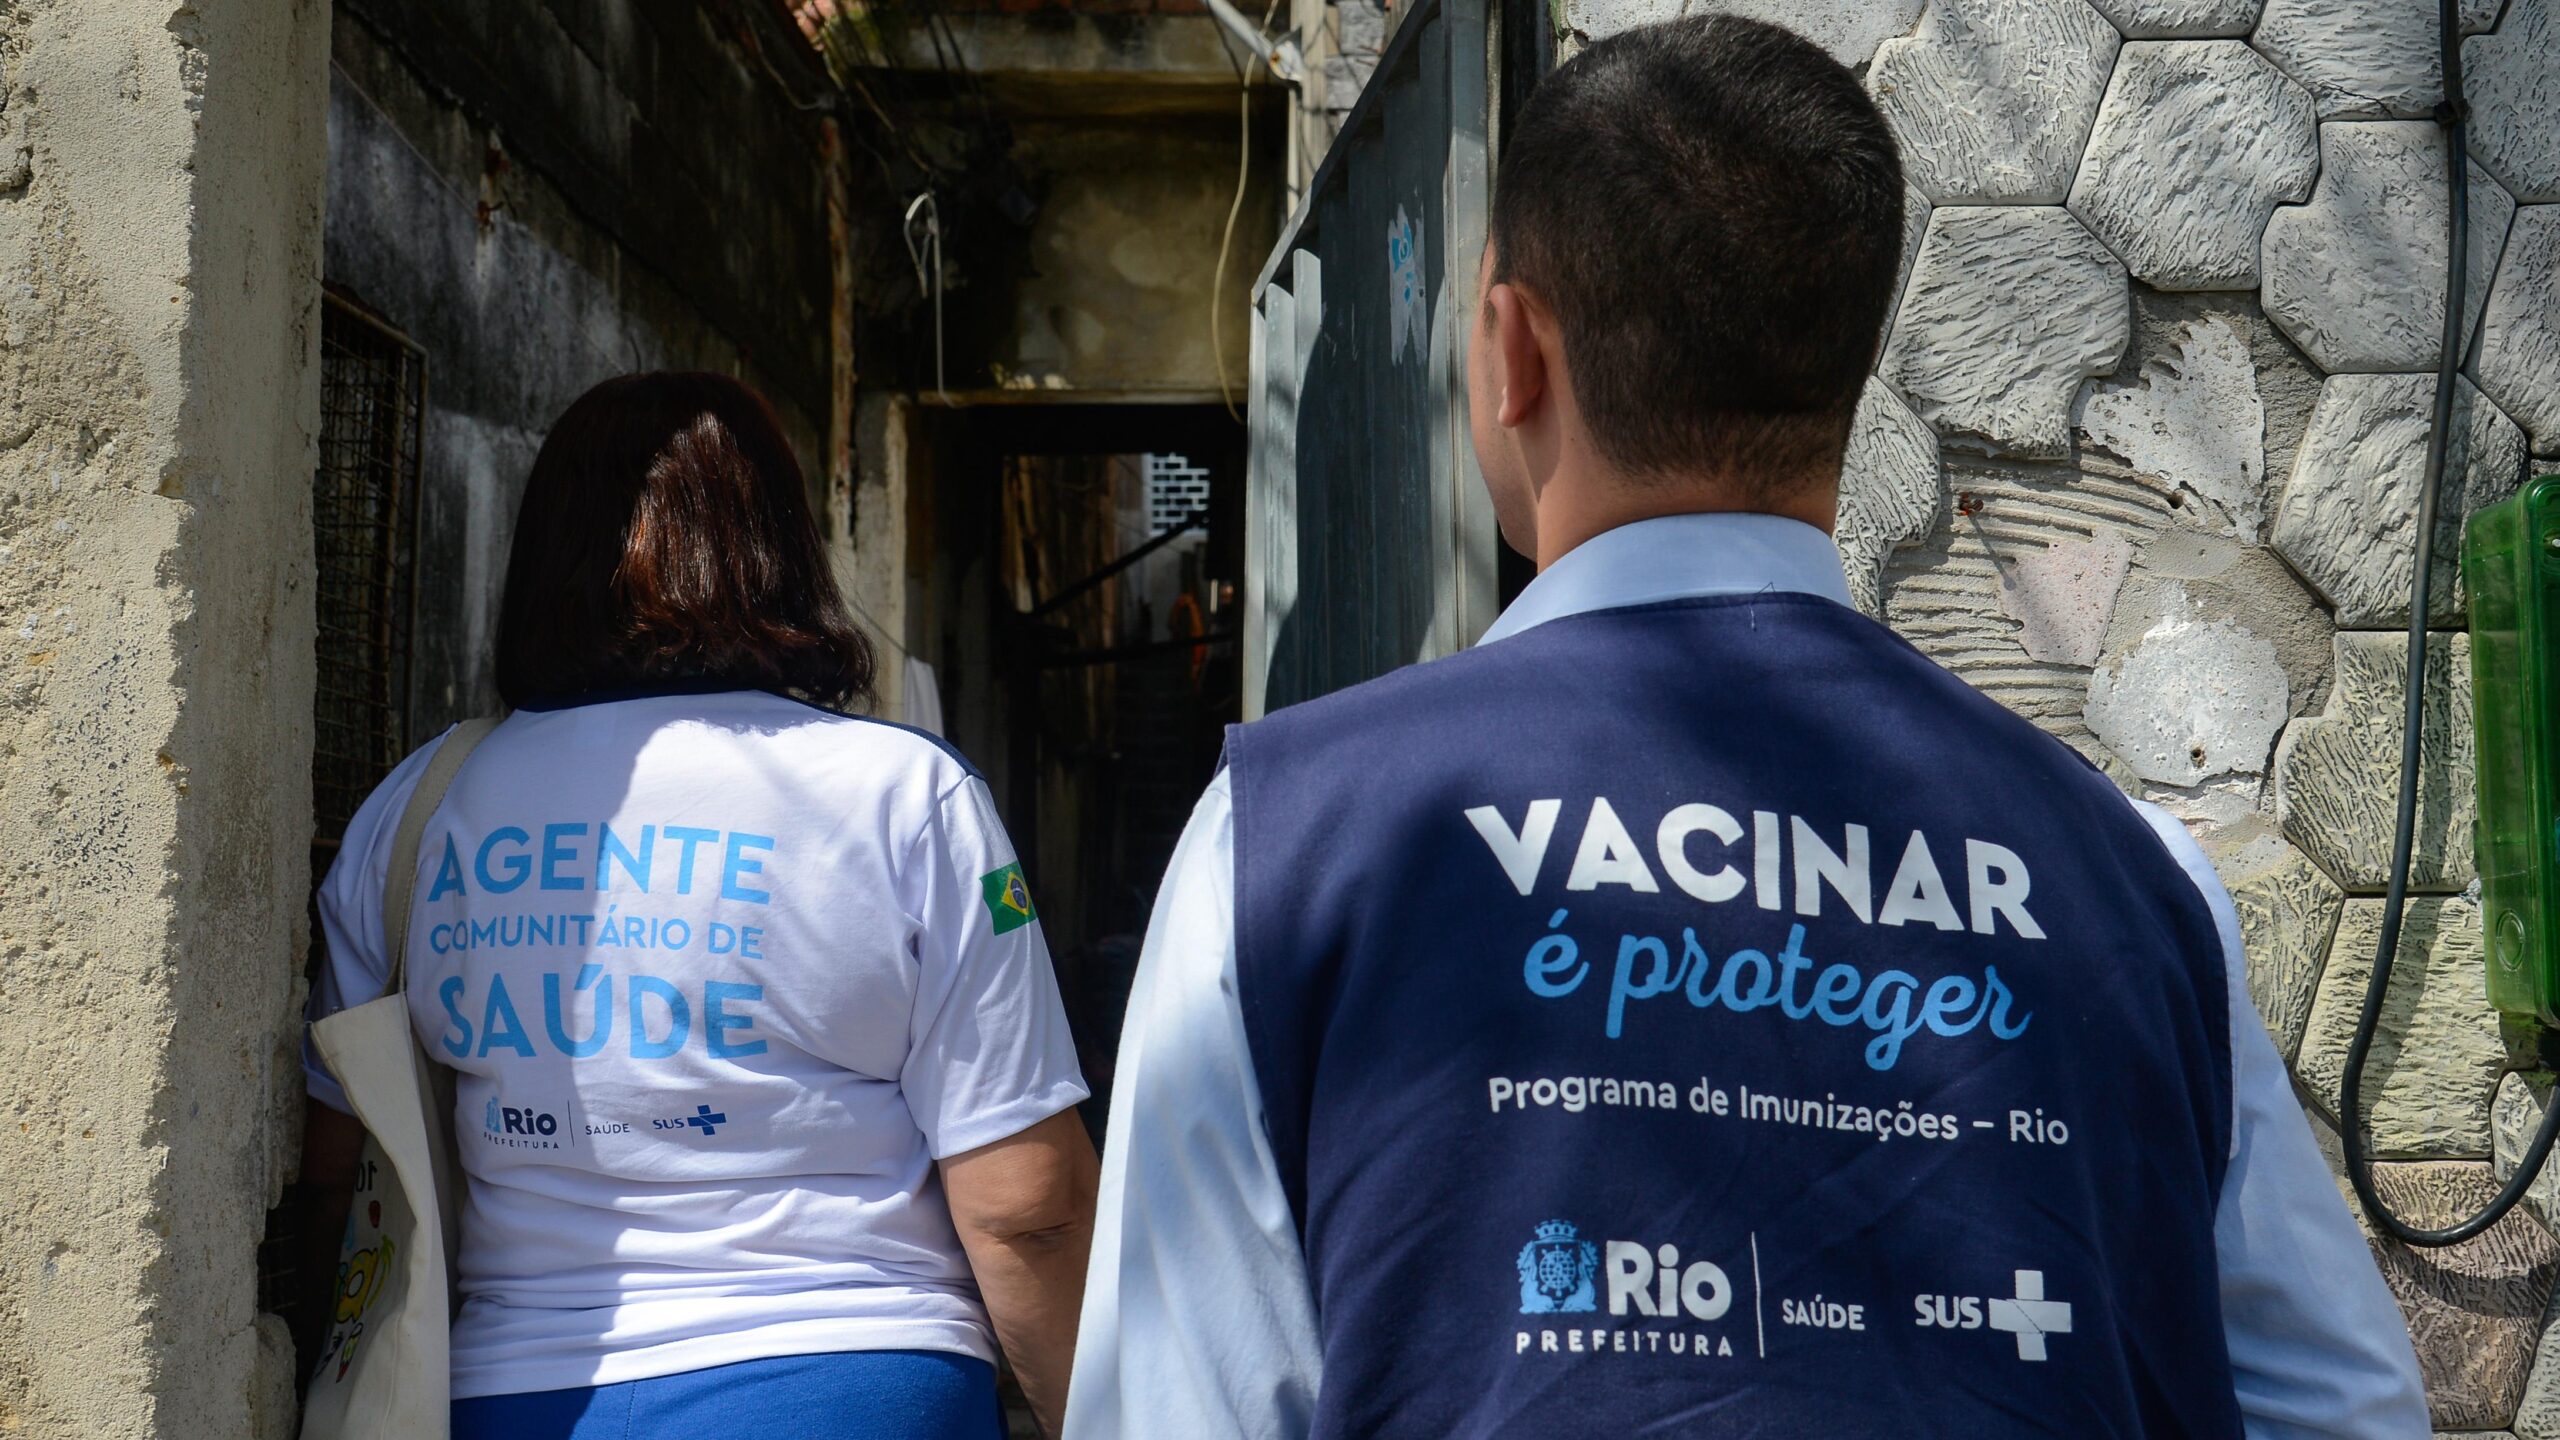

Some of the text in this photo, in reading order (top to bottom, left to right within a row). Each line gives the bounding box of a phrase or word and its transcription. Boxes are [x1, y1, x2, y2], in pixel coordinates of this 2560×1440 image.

[427, 821, 775, 905] AGENTE
[1464, 796, 2047, 940] VACINAR
[429, 904, 764, 960] COMUNITÁRIO DE
[438, 964, 769, 1060] SAÚDE
[1523, 908, 2032, 1071] é proteger
[502, 1107, 558, 1136] Rio
[585, 1121, 631, 1136] SAÚDE
[653, 1117, 686, 1130] SUS
[1489, 1077, 1677, 1113] Programa
[1690, 1077, 1729, 1117] de
[1741, 1085, 1959, 1142] Imunizações
[2009, 1108, 2070, 1145] Rio
[484, 1131, 560, 1150] PREFEITURA
[1606, 1239, 1733, 1321] Rio
[1782, 1294, 1866, 1331] SAÚDE
[1914, 1294, 1983, 1329] SUS
[1515, 1329, 1734, 1357] PREFEITURA
